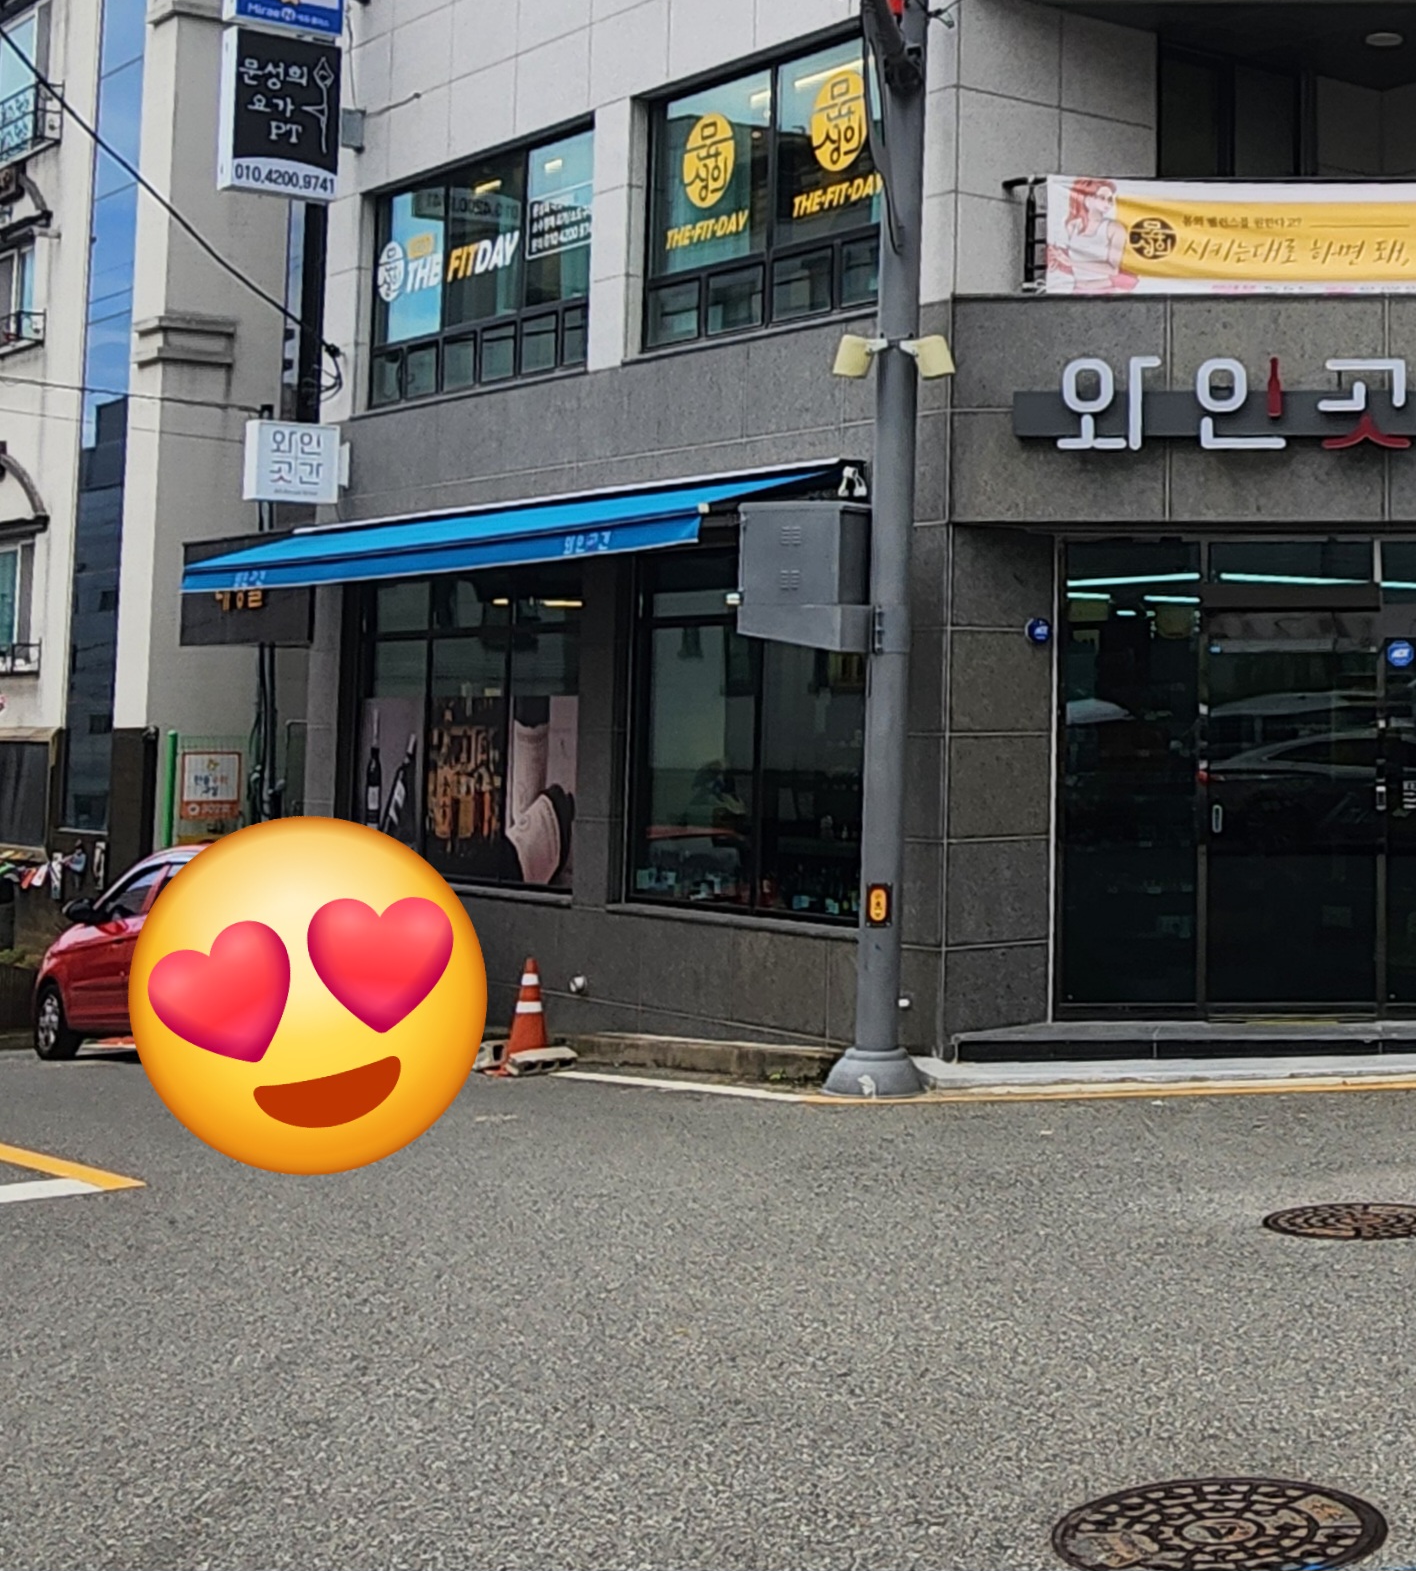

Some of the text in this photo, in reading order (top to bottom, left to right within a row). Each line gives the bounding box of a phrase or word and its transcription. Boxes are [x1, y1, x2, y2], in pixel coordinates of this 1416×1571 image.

[238, 58, 308, 90] 문성희
[247, 94, 296, 118] 요가
[269, 120, 303, 144] PT
[235, 164, 335, 194] 010.4200.9741
[405, 252, 443, 294] THE
[271, 430, 321, 456] 와인
[269, 460, 323, 486] 곳간
